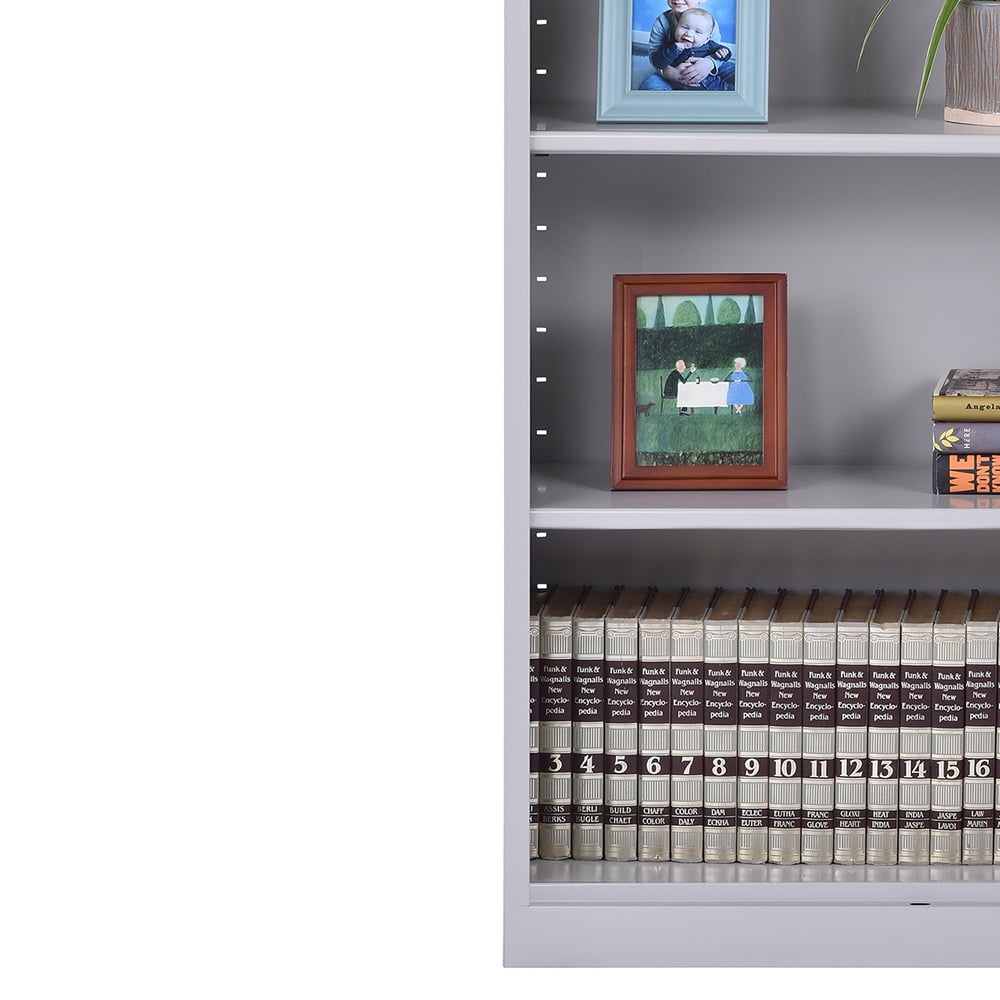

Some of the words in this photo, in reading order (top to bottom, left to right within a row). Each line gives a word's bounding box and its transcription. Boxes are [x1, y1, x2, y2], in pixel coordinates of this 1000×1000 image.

[949, 455, 975, 493] WE
[976, 455, 990, 493] DON'T
[672, 678, 702, 687] Wagnalls
[837, 681, 867, 690] Wagnalls
[549, 754, 562, 771] 3
[580, 755, 595, 774] 4
[614, 756, 627, 773] 5
[647, 756, 661, 774] 6
[681, 757, 693, 774] 7
[712, 758, 726, 776] 8
[744, 758, 759, 777] 9
[774, 759, 796, 777] 10
[810, 760, 828, 778] 11
[840, 759, 863, 777] 12
[871, 760, 893, 778] 13
[904, 760, 926, 778] 14
[937, 761, 960, 779] 15
[968, 759, 990, 777] 16
